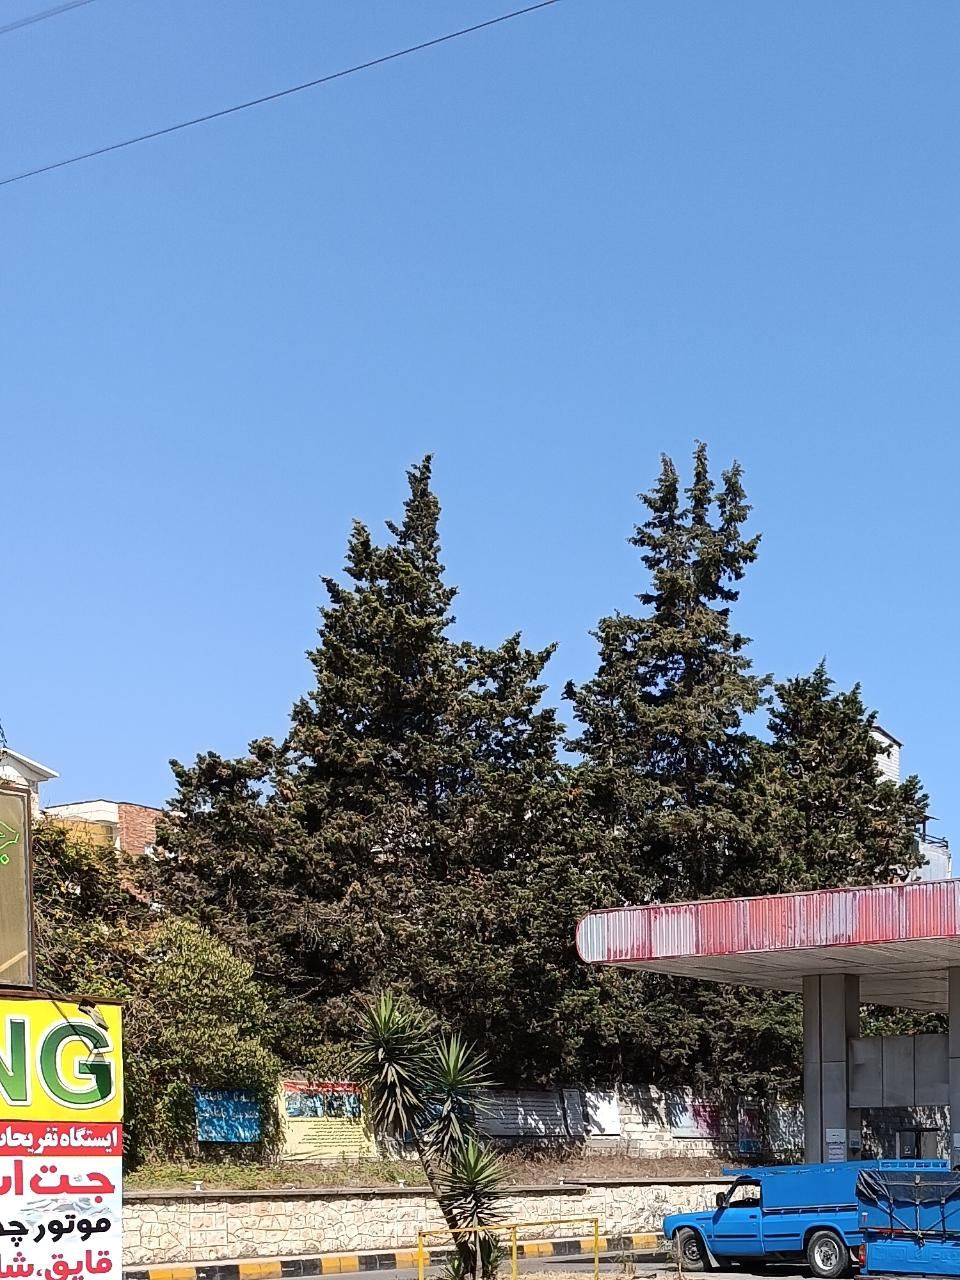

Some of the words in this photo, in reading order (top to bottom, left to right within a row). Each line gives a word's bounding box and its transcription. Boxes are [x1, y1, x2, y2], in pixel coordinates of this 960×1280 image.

[60, 1126, 118, 1153] ایستگاه
[29, 1165, 115, 1204] جت
[33, 1214, 112, 1243] موتور
